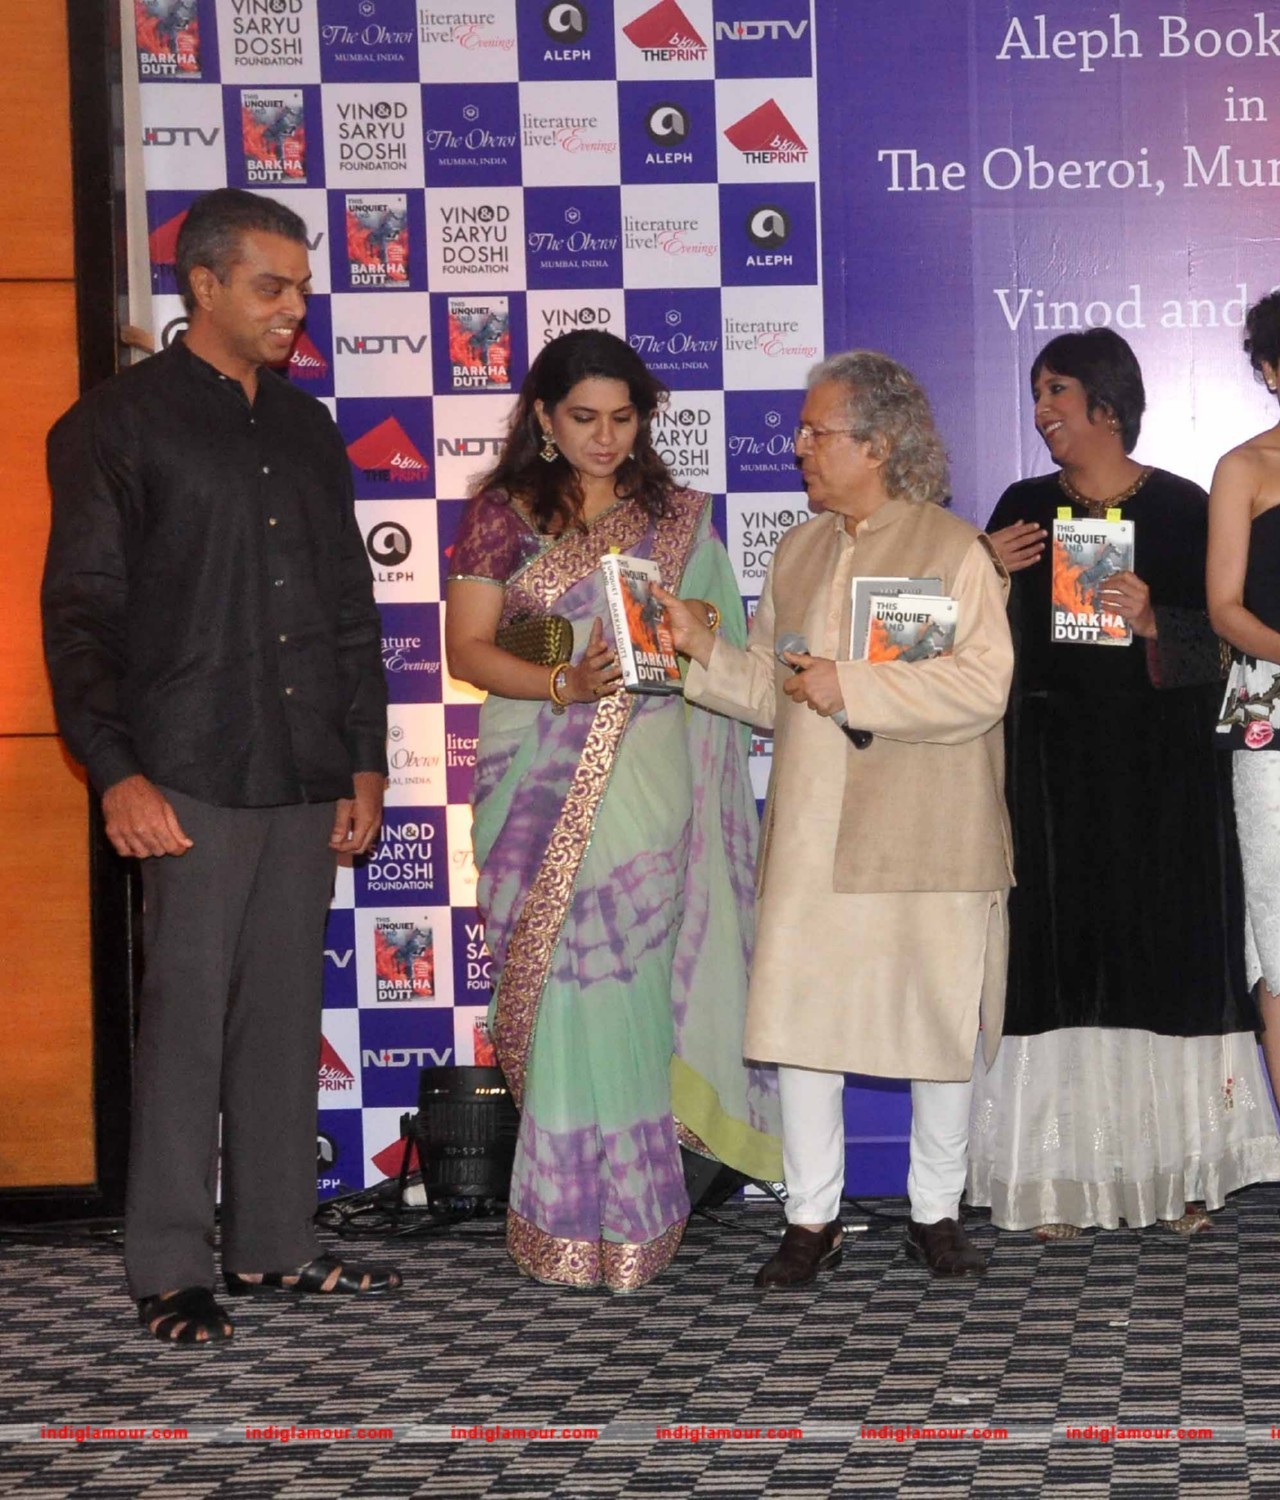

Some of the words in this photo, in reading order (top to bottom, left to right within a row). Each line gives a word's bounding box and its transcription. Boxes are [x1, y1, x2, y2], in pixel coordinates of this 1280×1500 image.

[419, 10, 495, 25] literature
[233, 18, 299, 35] SARYU
[716, 20, 808, 40] NDTV
[322, 25, 359, 45] The
[361, 24, 413, 45] Oberoi
[420, 30, 454, 43] live!
[455, 23, 514, 49] Evenings
[236, 38, 302, 55] DOSHI
[996, 14, 1142, 72] Aleph
[141, 53, 196, 65] BARKHA
[235, 57, 303, 66] FOUNDATION
[377, 53, 404, 61] INDIA
[544, 50, 591, 61] ALEPH
[642, 49, 708, 61] THEPRINT
[142, 64, 177, 75] DUTT
[244, 100, 284, 108] UNQUIET
[1225, 86, 1267, 122] in
[523, 114, 597, 128] literature
[339, 123, 404, 139] SARYU
[426, 129, 462, 151] The
[465, 128, 517, 149] Oberoi
[524, 132, 557, 146] live!
[557, 129, 616, 154] Evenings
[340, 143, 406, 160] DOSHI
[645, 153, 693, 164] ALEPH
[742, 151, 808, 164] THEPRINT
[248, 160, 302, 171] BARKHA
[340, 162, 406, 171] FOUNDATION
[480, 157, 507, 165] INDIA
[248, 170, 283, 181] DUTT
[878, 149, 966, 192] The
[983, 145, 1165, 195] Oberoi,
[349, 204, 388, 213] UNQUIET
[624, 216, 698, 231] literature
[442, 225, 507, 243] SARYU
[528, 232, 565, 253] The
[567, 230, 617, 252] Oberoi
[625, 233, 657, 249] live!
[658, 230, 717, 255] Evenings
[443, 246, 508, 263] DOSHI
[745, 255, 793, 266] ALEPH
[350, 263, 406, 274] BARKHA
[443, 265, 508, 274] FOUNDATION
[582, 259, 608, 267] INDIA
[351, 274, 386, 285] DUTT
[451, 307, 489, 316] UNQUIET
[993, 285, 1146, 331] Vinod
[1160, 284, 1248, 330] and
[725, 318, 799, 333] literature
[336, 335, 427, 354] NDTV
[630, 333, 666, 354] The
[668, 332, 719, 354] Oberoi
[726, 335, 758, 350] live!
[758, 332, 817, 357] Evenings
[453, 366, 506, 377] BARKHA
[682, 361, 708, 369] INDIA
[453, 376, 488, 387] DUTT
[729, 435, 765, 456] The
[363, 469, 428, 482] THEPRINT
[1056, 525, 1075, 533] THIS
[1057, 533, 1108, 545] UNQUIET
[876, 602, 898, 611] THIS
[876, 611, 931, 624] UNQUIET
[1055, 611, 1126, 628] BARKHA
[1055, 626, 1100, 640] DUTT
[383, 648, 440, 673] Evenings
[634, 650, 678, 669] BARKHA
[638, 665, 666, 681] DUTT
[390, 749, 440, 769] Oberoi
[368, 862, 433, 880] DOSHI
[367, 881, 434, 891] FOUNDATION
[376, 922, 414, 931] UNQUIET
[378, 980, 431, 990] BARKHA
[378, 989, 412, 1000] DUTT
[362, 1048, 452, 1067] NDTV
